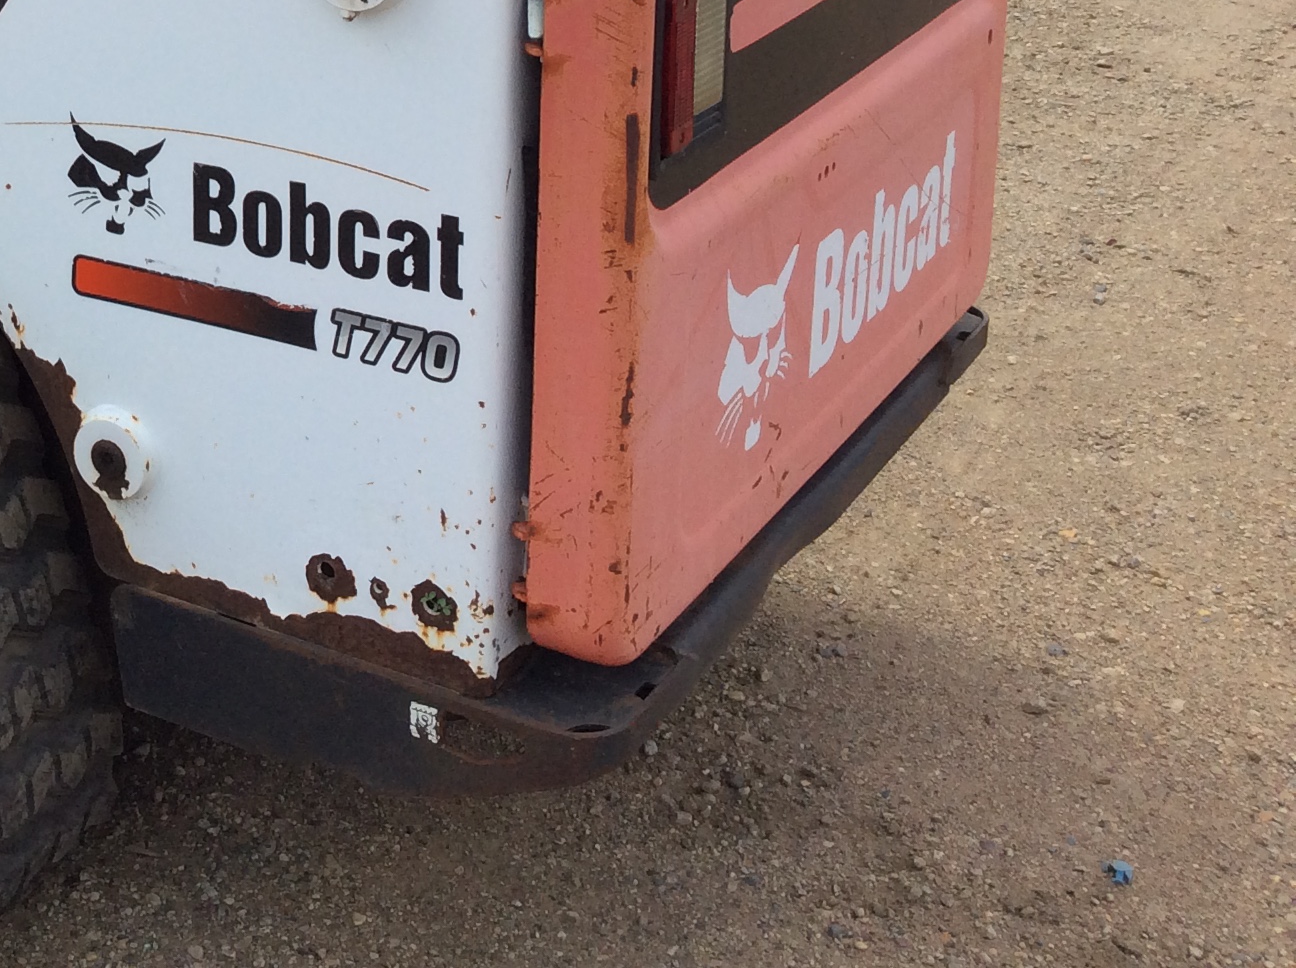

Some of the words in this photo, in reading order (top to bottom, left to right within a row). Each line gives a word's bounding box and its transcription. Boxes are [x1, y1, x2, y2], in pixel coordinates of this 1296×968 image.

[193, 162, 465, 300] Bobcat
[808, 130, 956, 378] Bobcat
[330, 308, 460, 383] T770
